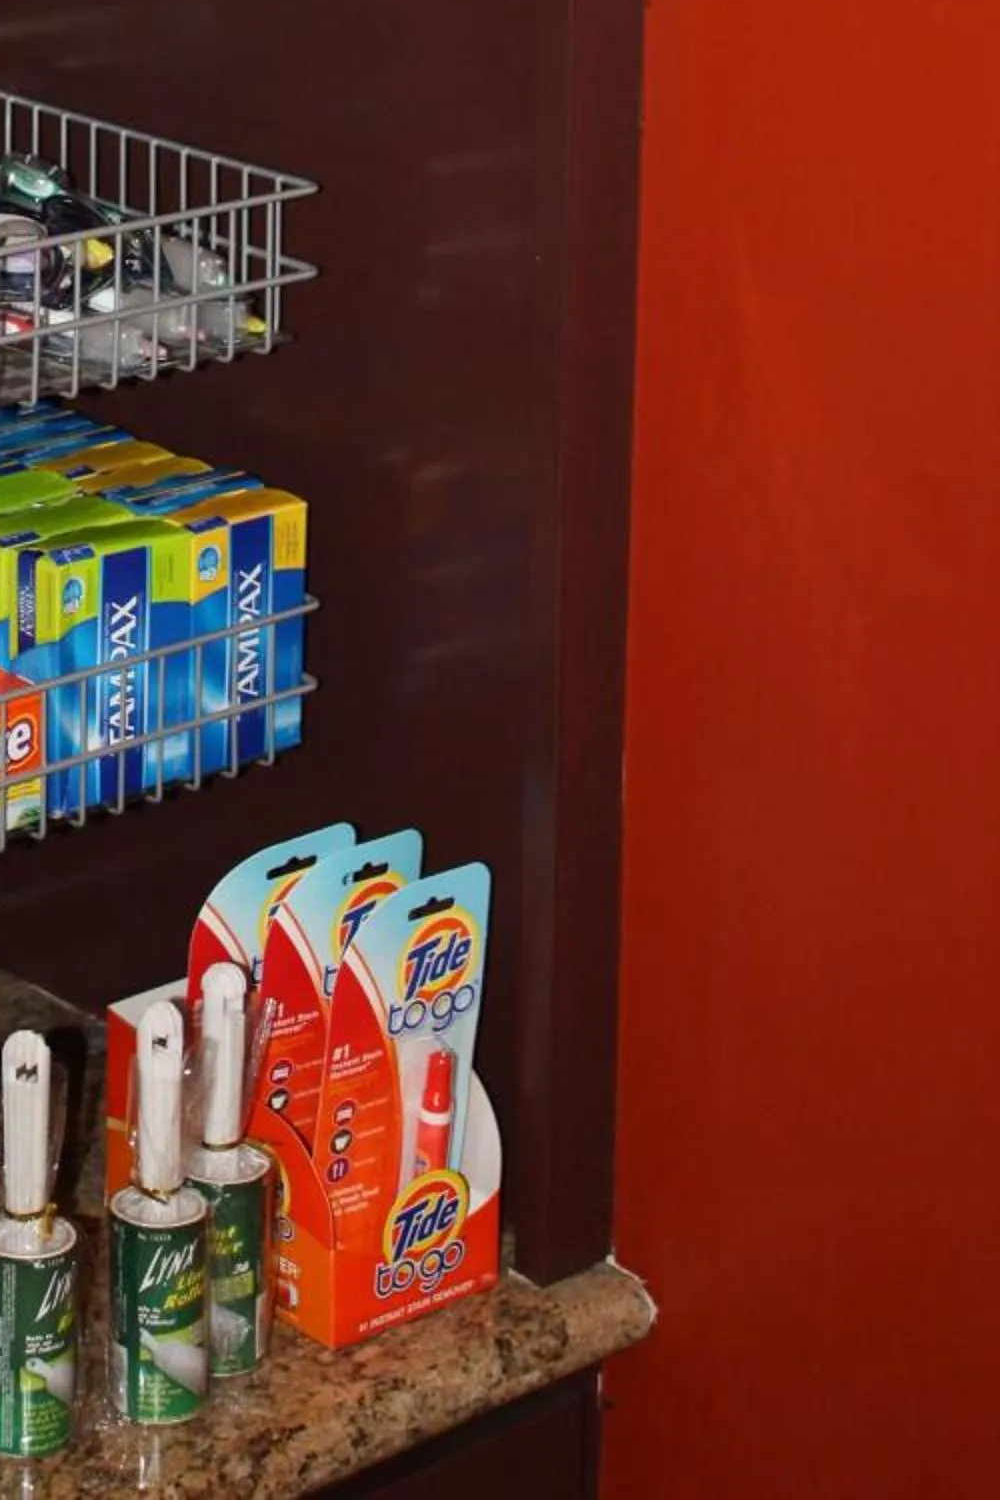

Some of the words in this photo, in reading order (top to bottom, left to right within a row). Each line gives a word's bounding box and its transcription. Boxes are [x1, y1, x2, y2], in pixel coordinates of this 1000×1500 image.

[110, 595, 137, 757] TAMPAX
[405, 931, 471, 1002] Tide
[386, 1000, 426, 1037] to
[431, 983, 475, 1033] go
[393, 1190, 459, 1264] Tide
[35, 1268, 74, 1322] LYN
[139, 1239, 199, 1292] LYNX
[375, 1257, 416, 1299] to
[420, 1240, 464, 1293] go
